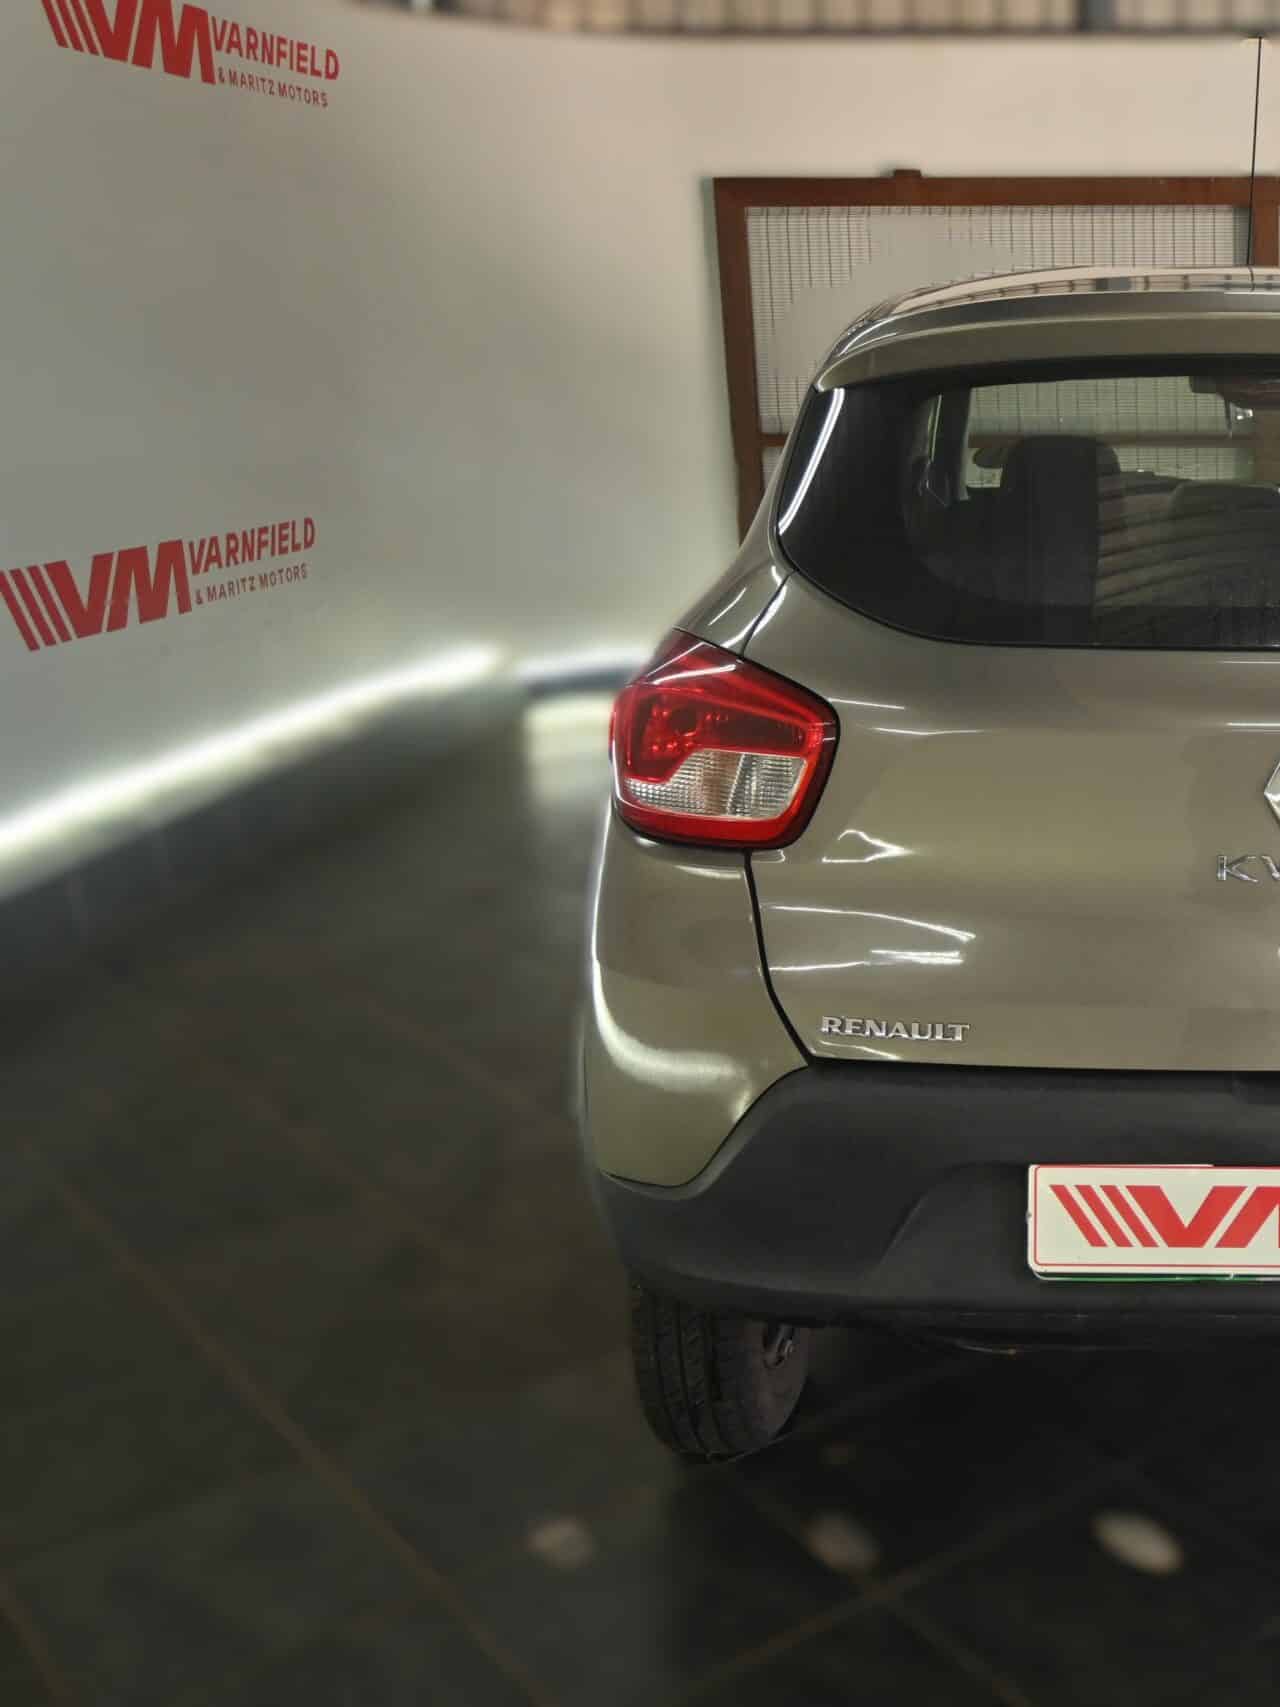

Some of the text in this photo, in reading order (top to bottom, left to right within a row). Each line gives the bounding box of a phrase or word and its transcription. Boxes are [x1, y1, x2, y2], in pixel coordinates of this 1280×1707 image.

[211, 16, 340, 80] VARNFIELD
[217, 66, 328, 108] & MARITZ MOTORS
[188, 517, 315, 575] VARNFIELD
[207, 576, 256, 602] MARITZ
[259, 563, 308, 589] MOTORS
[820, 1015, 970, 1041] RENAULT
